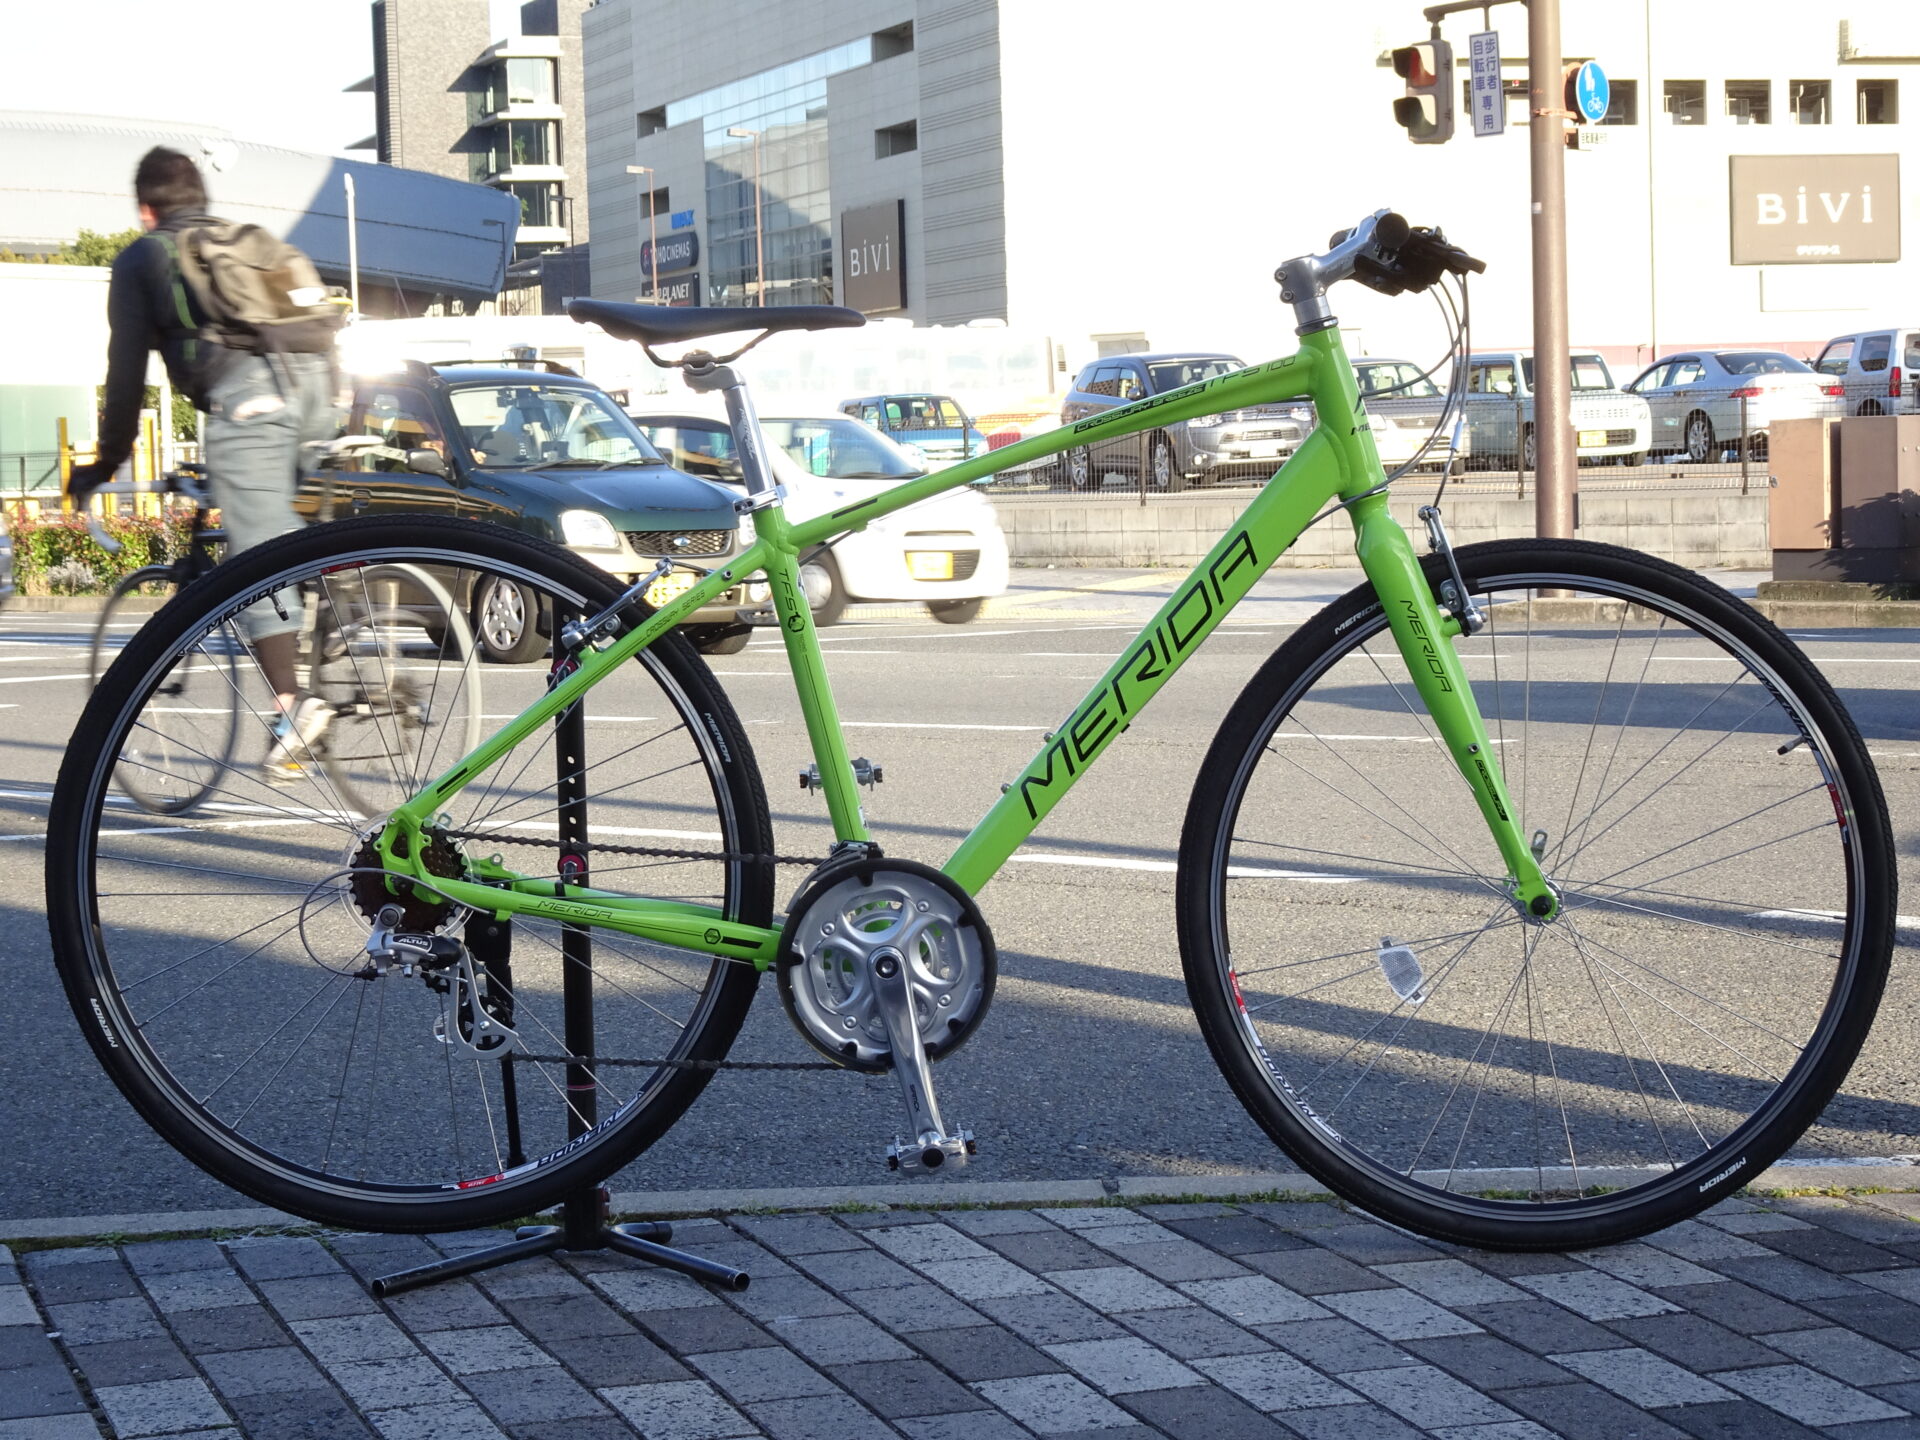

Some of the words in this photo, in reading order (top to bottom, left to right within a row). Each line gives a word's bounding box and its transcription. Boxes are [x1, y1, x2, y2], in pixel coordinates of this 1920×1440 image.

[1473, 40, 1486, 91] 自転車
[1484, 38, 1498, 90] 歩行者
[1482, 95, 1494, 130] 専用
[1756, 185, 1873, 225] BiVi
[666, 241, 690, 261] CINEMAS
[850, 234, 891, 277] BiVi
[662, 283, 690, 301] PLANET
[1077, 400, 1151, 432] CROSSWAY
[1267, 356, 1296, 372] 100
[779, 568, 797, 611] TFS
[1400, 600, 1452, 692] MERIDA
[1020, 530, 1258, 821] MERIDA
[704, 712, 731, 763] MERIDA
[538, 900, 613, 919] MERIDA
[398, 938, 428, 946] ALTUS
[90, 998, 119, 1047] MERIDA
[1700, 1156, 1747, 1192] MERIDA
